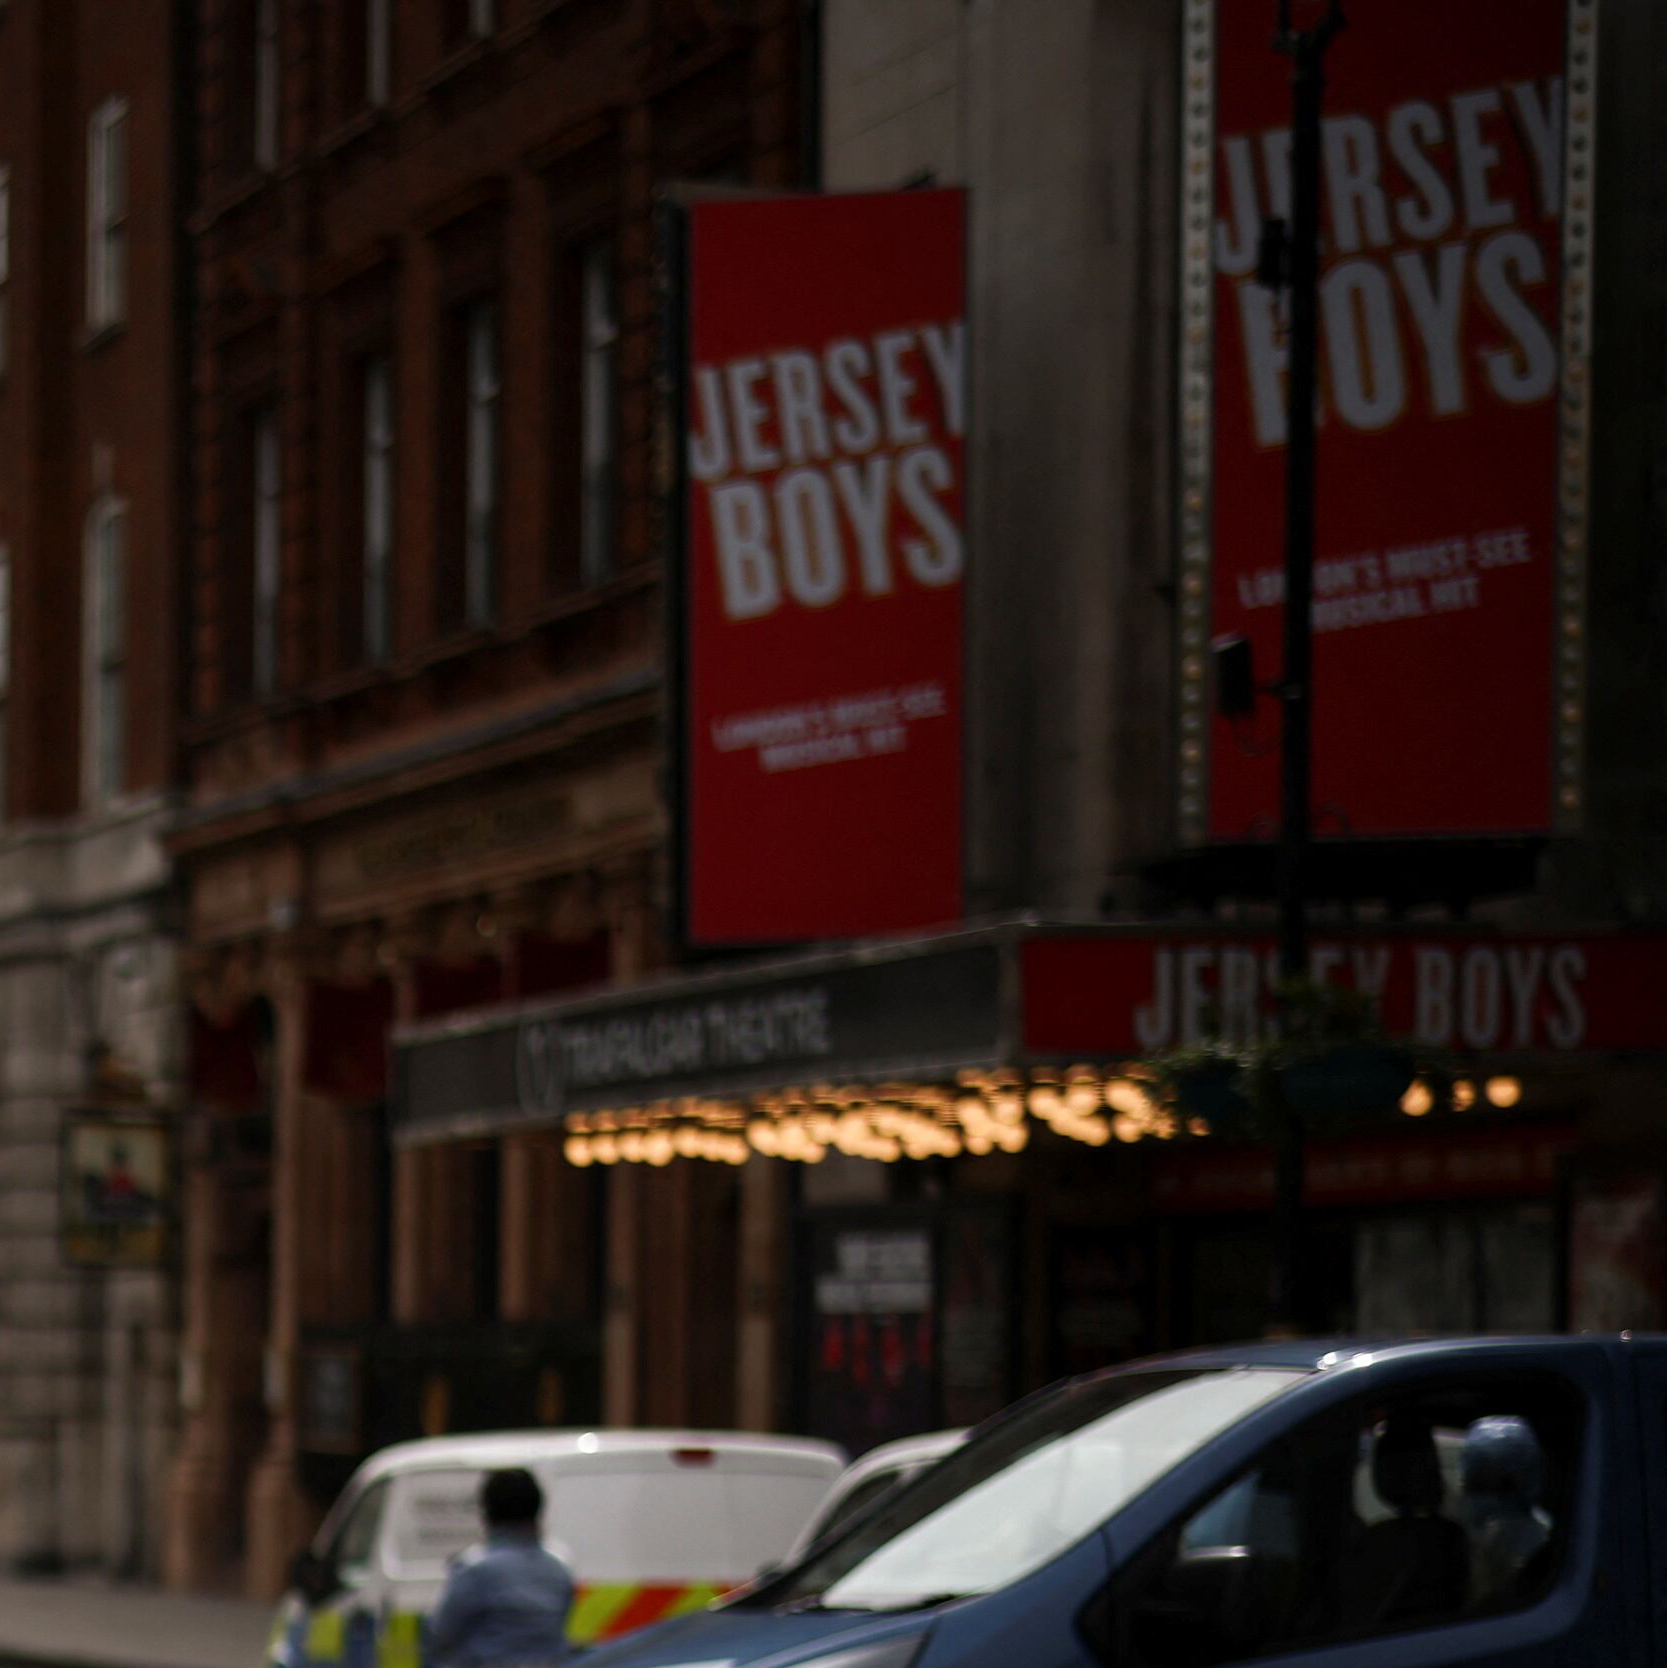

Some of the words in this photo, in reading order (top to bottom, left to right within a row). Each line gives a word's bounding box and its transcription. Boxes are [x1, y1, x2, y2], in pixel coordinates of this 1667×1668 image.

[689, 320, 965, 481] JERSEY
[711, 447, 962, 622] BOYS
[1411, 942, 1591, 1051] BOYS
